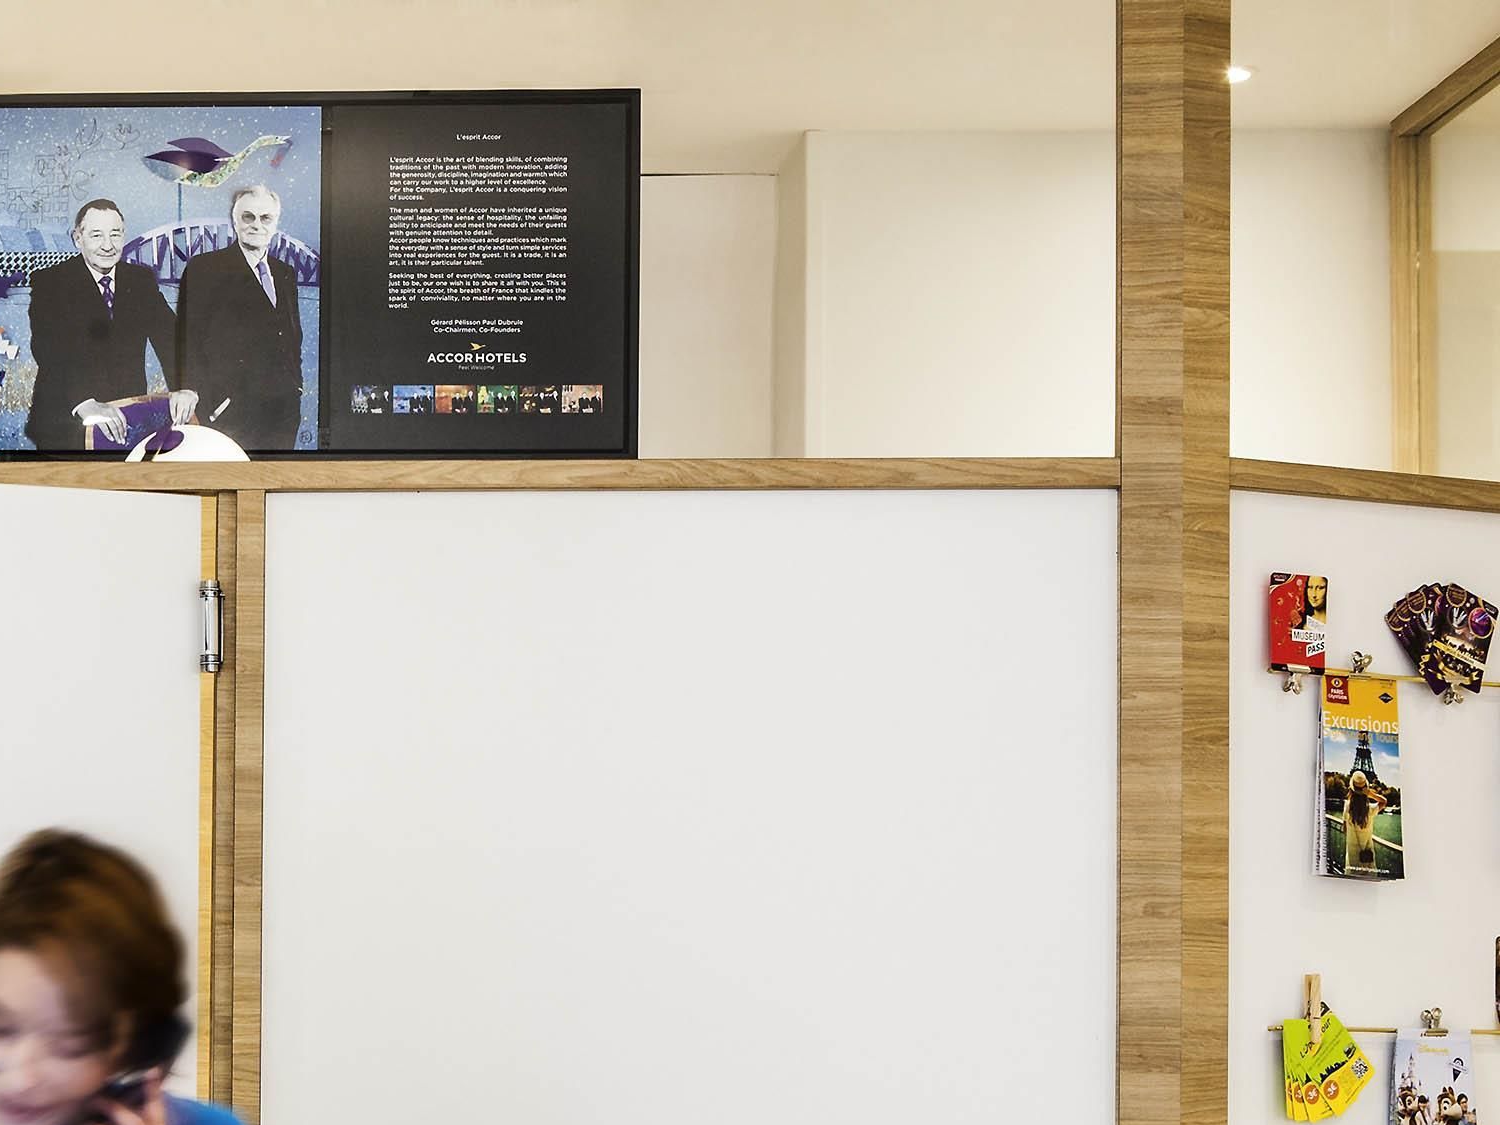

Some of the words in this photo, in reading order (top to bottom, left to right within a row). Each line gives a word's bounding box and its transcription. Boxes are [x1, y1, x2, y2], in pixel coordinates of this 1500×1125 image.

[456, 133, 481, 141] L'esprit
[390, 156, 414, 164] L'esprit
[475, 156, 504, 164] blending
[533, 156, 568, 164] combining
[445, 164, 460, 172] past
[544, 164, 567, 172] adding
[470, 171, 509, 179] imagination
[465, 179, 486, 187] higher
[449, 186, 473, 194] L'esprit
[509, 186, 547, 194] conquering
[544, 207, 567, 215] unique
[538, 214, 567, 222] unfailing
[389, 222, 410, 230] ability
[420, 222, 453, 230] anticipate
[545, 222, 567, 230] guests
[405, 229, 432, 237] genuine
[409, 237, 432, 245] people
[451, 237, 486, 245] techniques
[500, 237, 530, 245] practices
[431, 259, 462, 267] particular
[389, 272, 415, 280] Seeking
[494, 272, 521, 280] creating
[546, 272, 566, 280] places
[389, 295, 407, 303] spark
[427, 352, 473, 363] ACCOR
[475, 352, 526, 363] HOTELS
[1293, 631, 1325, 641] MUSEUM
[1307, 641, 1325, 655] PASS
[1323, 711, 1399, 734] Excursions
